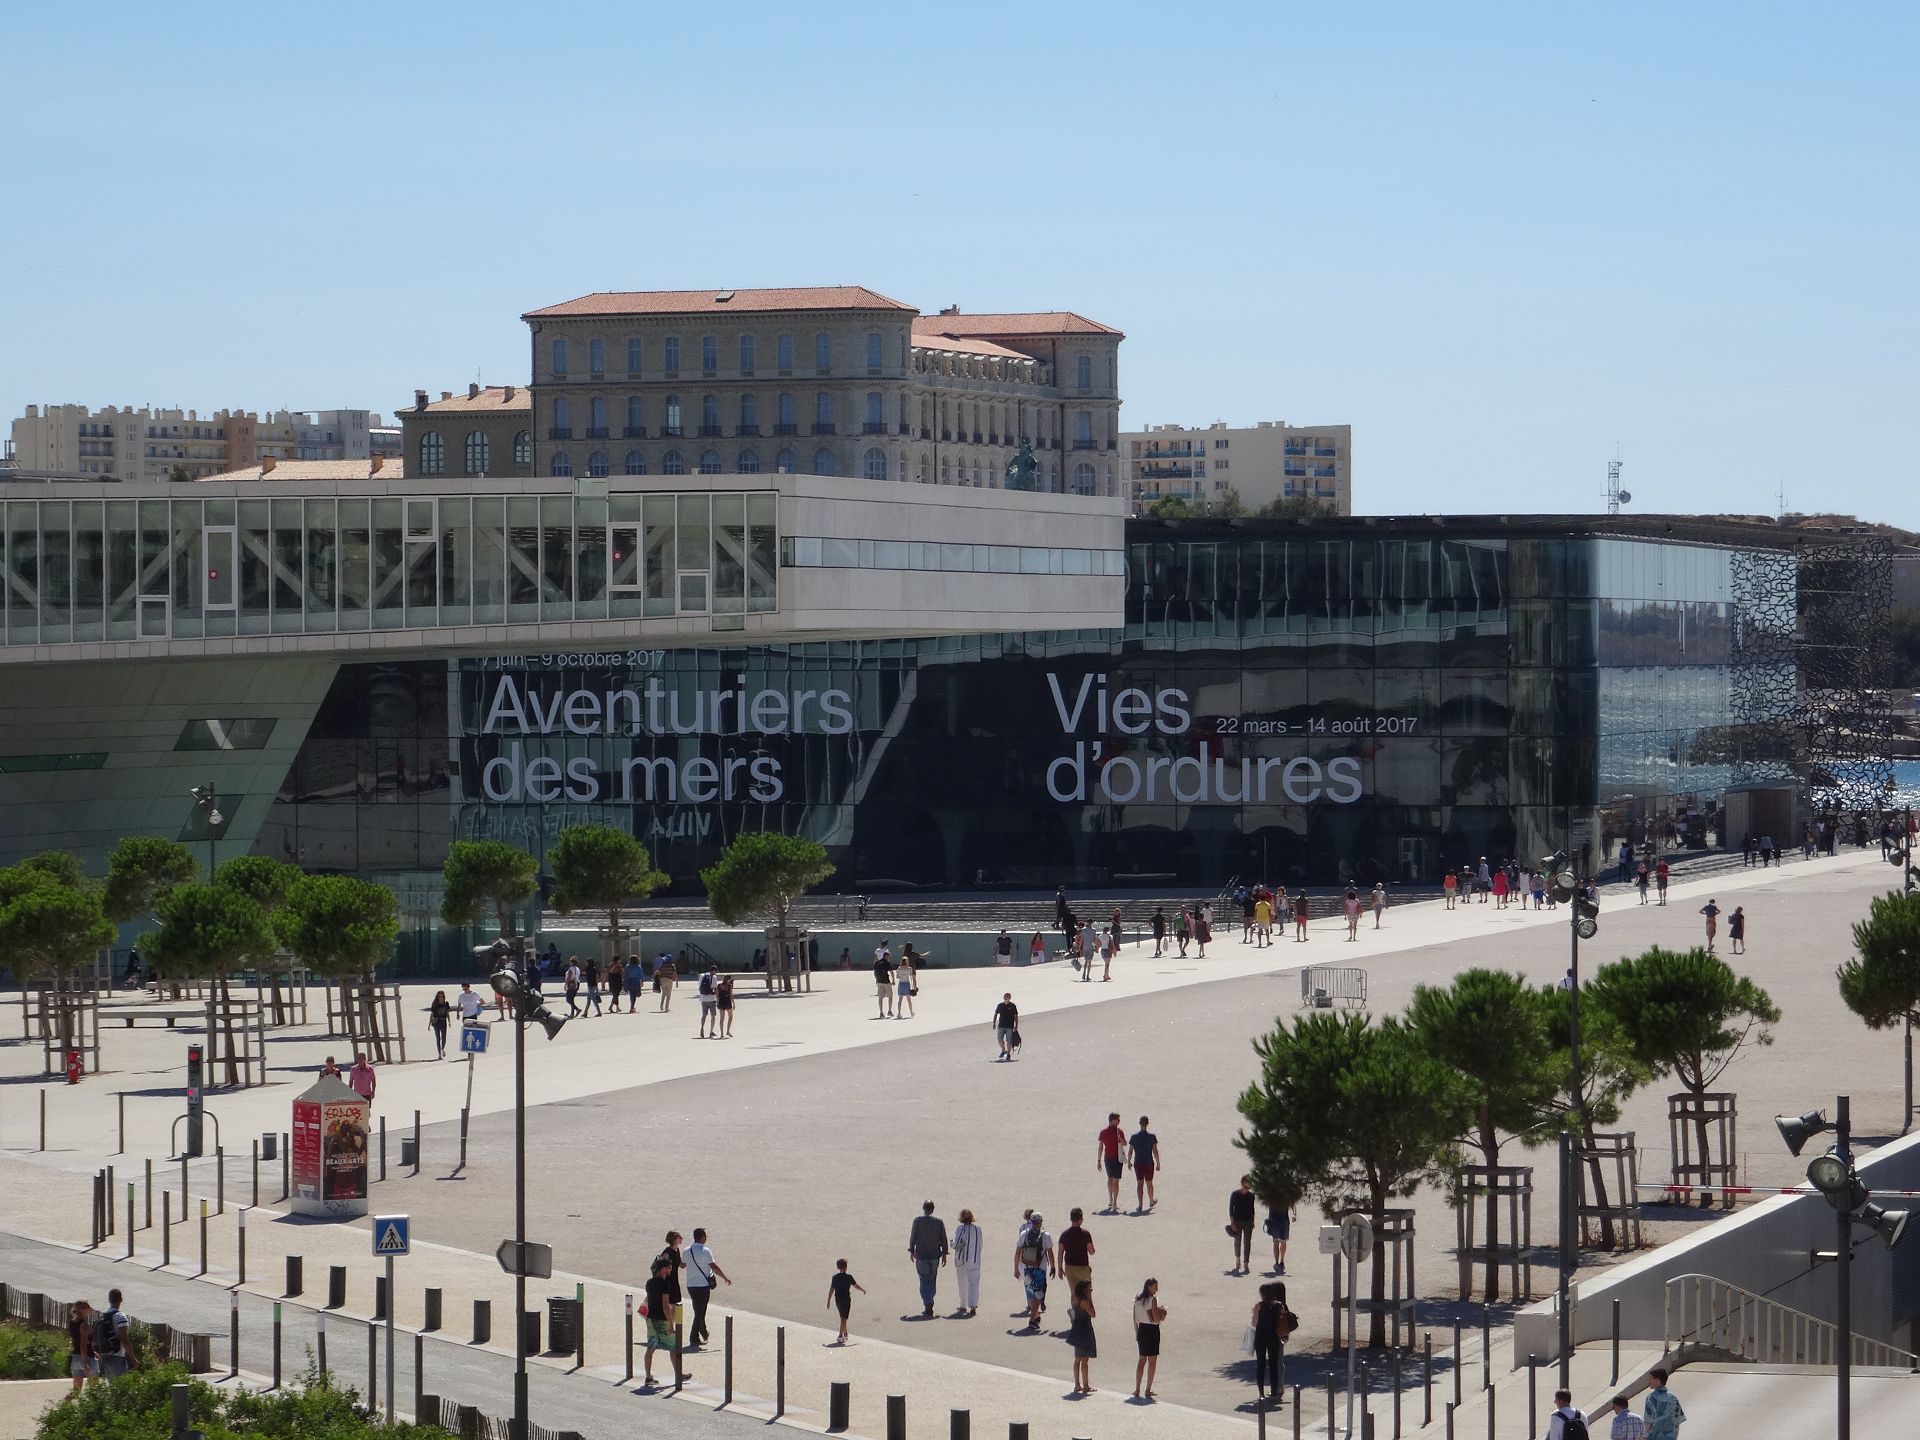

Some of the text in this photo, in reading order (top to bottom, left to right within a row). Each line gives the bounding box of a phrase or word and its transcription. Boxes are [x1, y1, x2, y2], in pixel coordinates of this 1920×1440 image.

[542, 653, 552, 666] 9
[557, 652, 622, 666] octobre
[627, 650, 666, 666] 2017
[483, 674, 853, 735] Aventuriers
[1046, 672, 1191, 735] Vies
[1216, 717, 1238, 733] 22
[1243, 720, 1287, 733] mars
[1307, 717, 1326, 733] 14
[1331, 716, 1370, 733] août
[1376, 717, 1418, 733] 2017
[483, 741, 783, 802] des mers
[325, 1158, 365, 1166] BEAUX-ARTS
